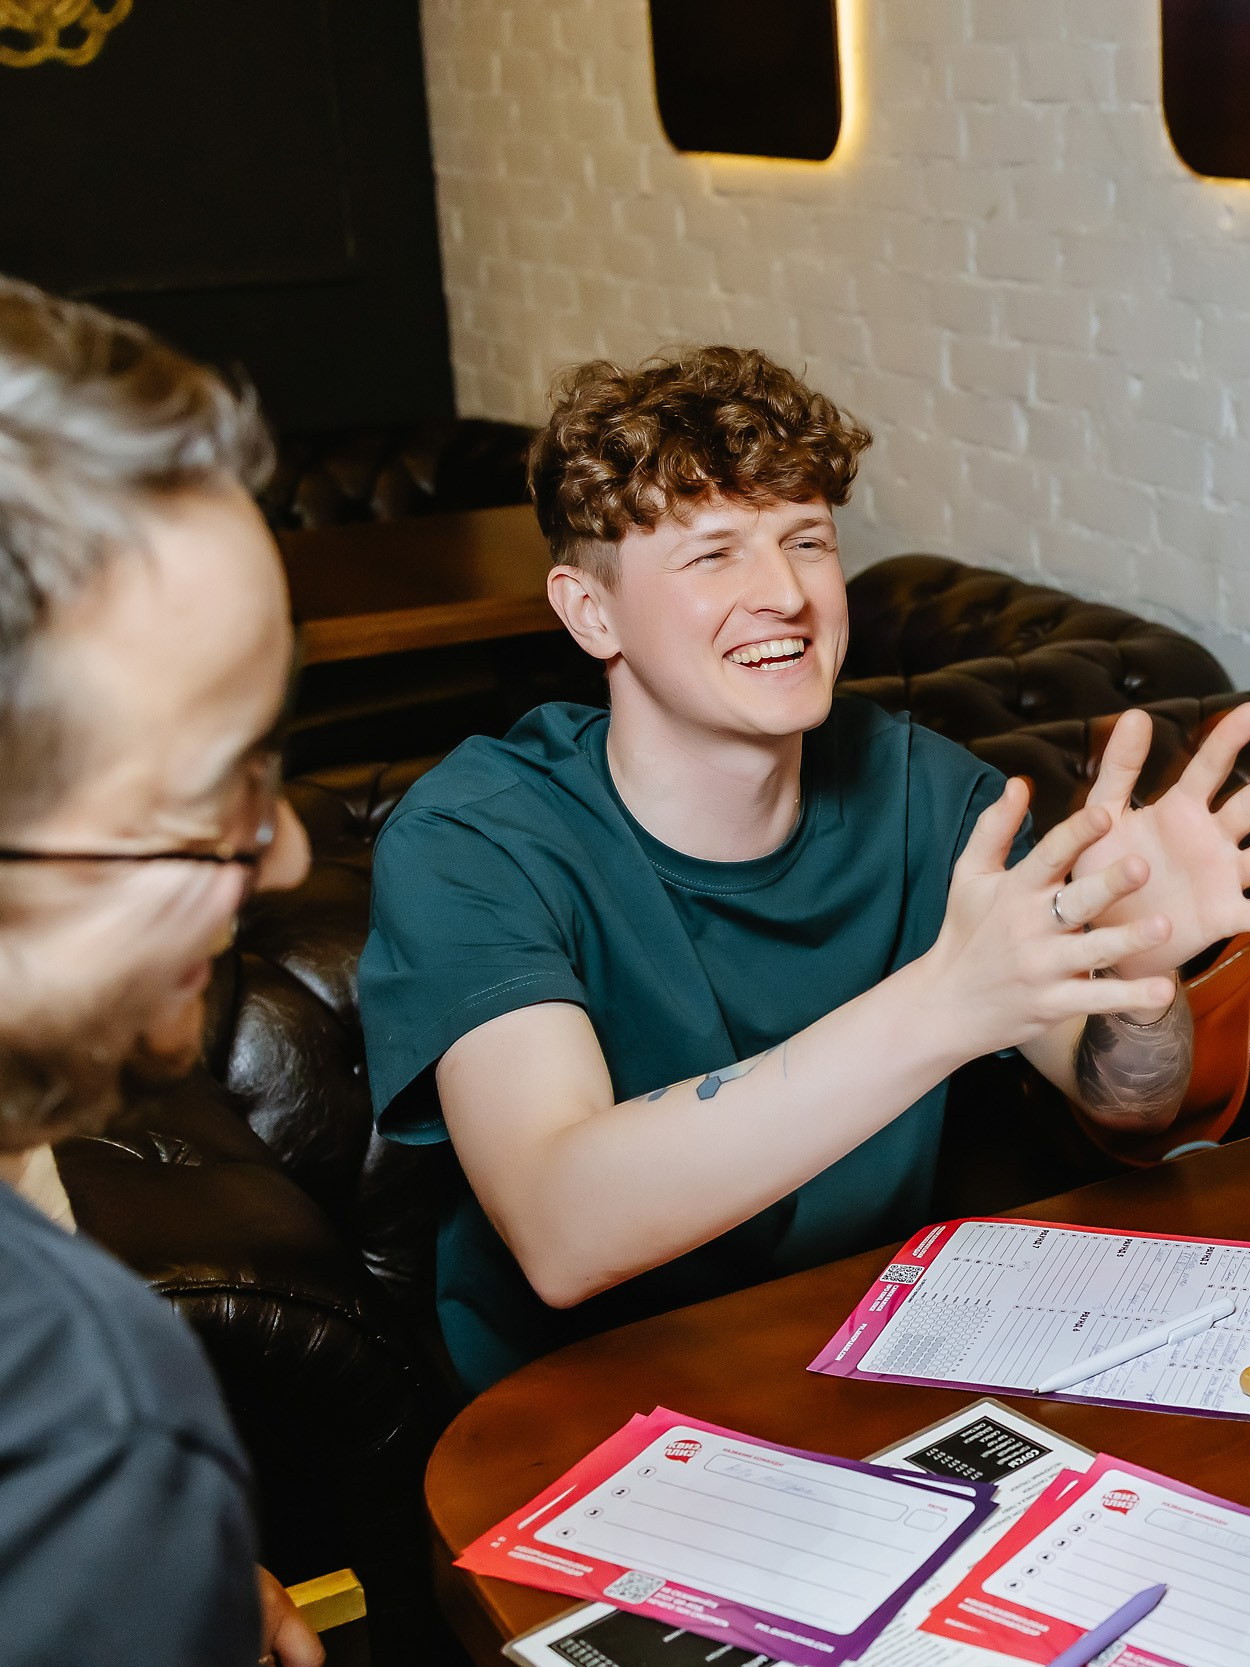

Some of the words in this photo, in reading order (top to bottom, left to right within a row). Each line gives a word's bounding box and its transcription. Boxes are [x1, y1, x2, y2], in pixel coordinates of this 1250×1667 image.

[1033, 1229, 1050, 1244] РАУНД
[1117, 1238, 1134, 1253] РАУНД
[1200, 1246, 1215, 1261] РАУНД
[1073, 1311, 1091, 1327] РАУНД
[1005, 1448, 1042, 1468] СОУСЫ
